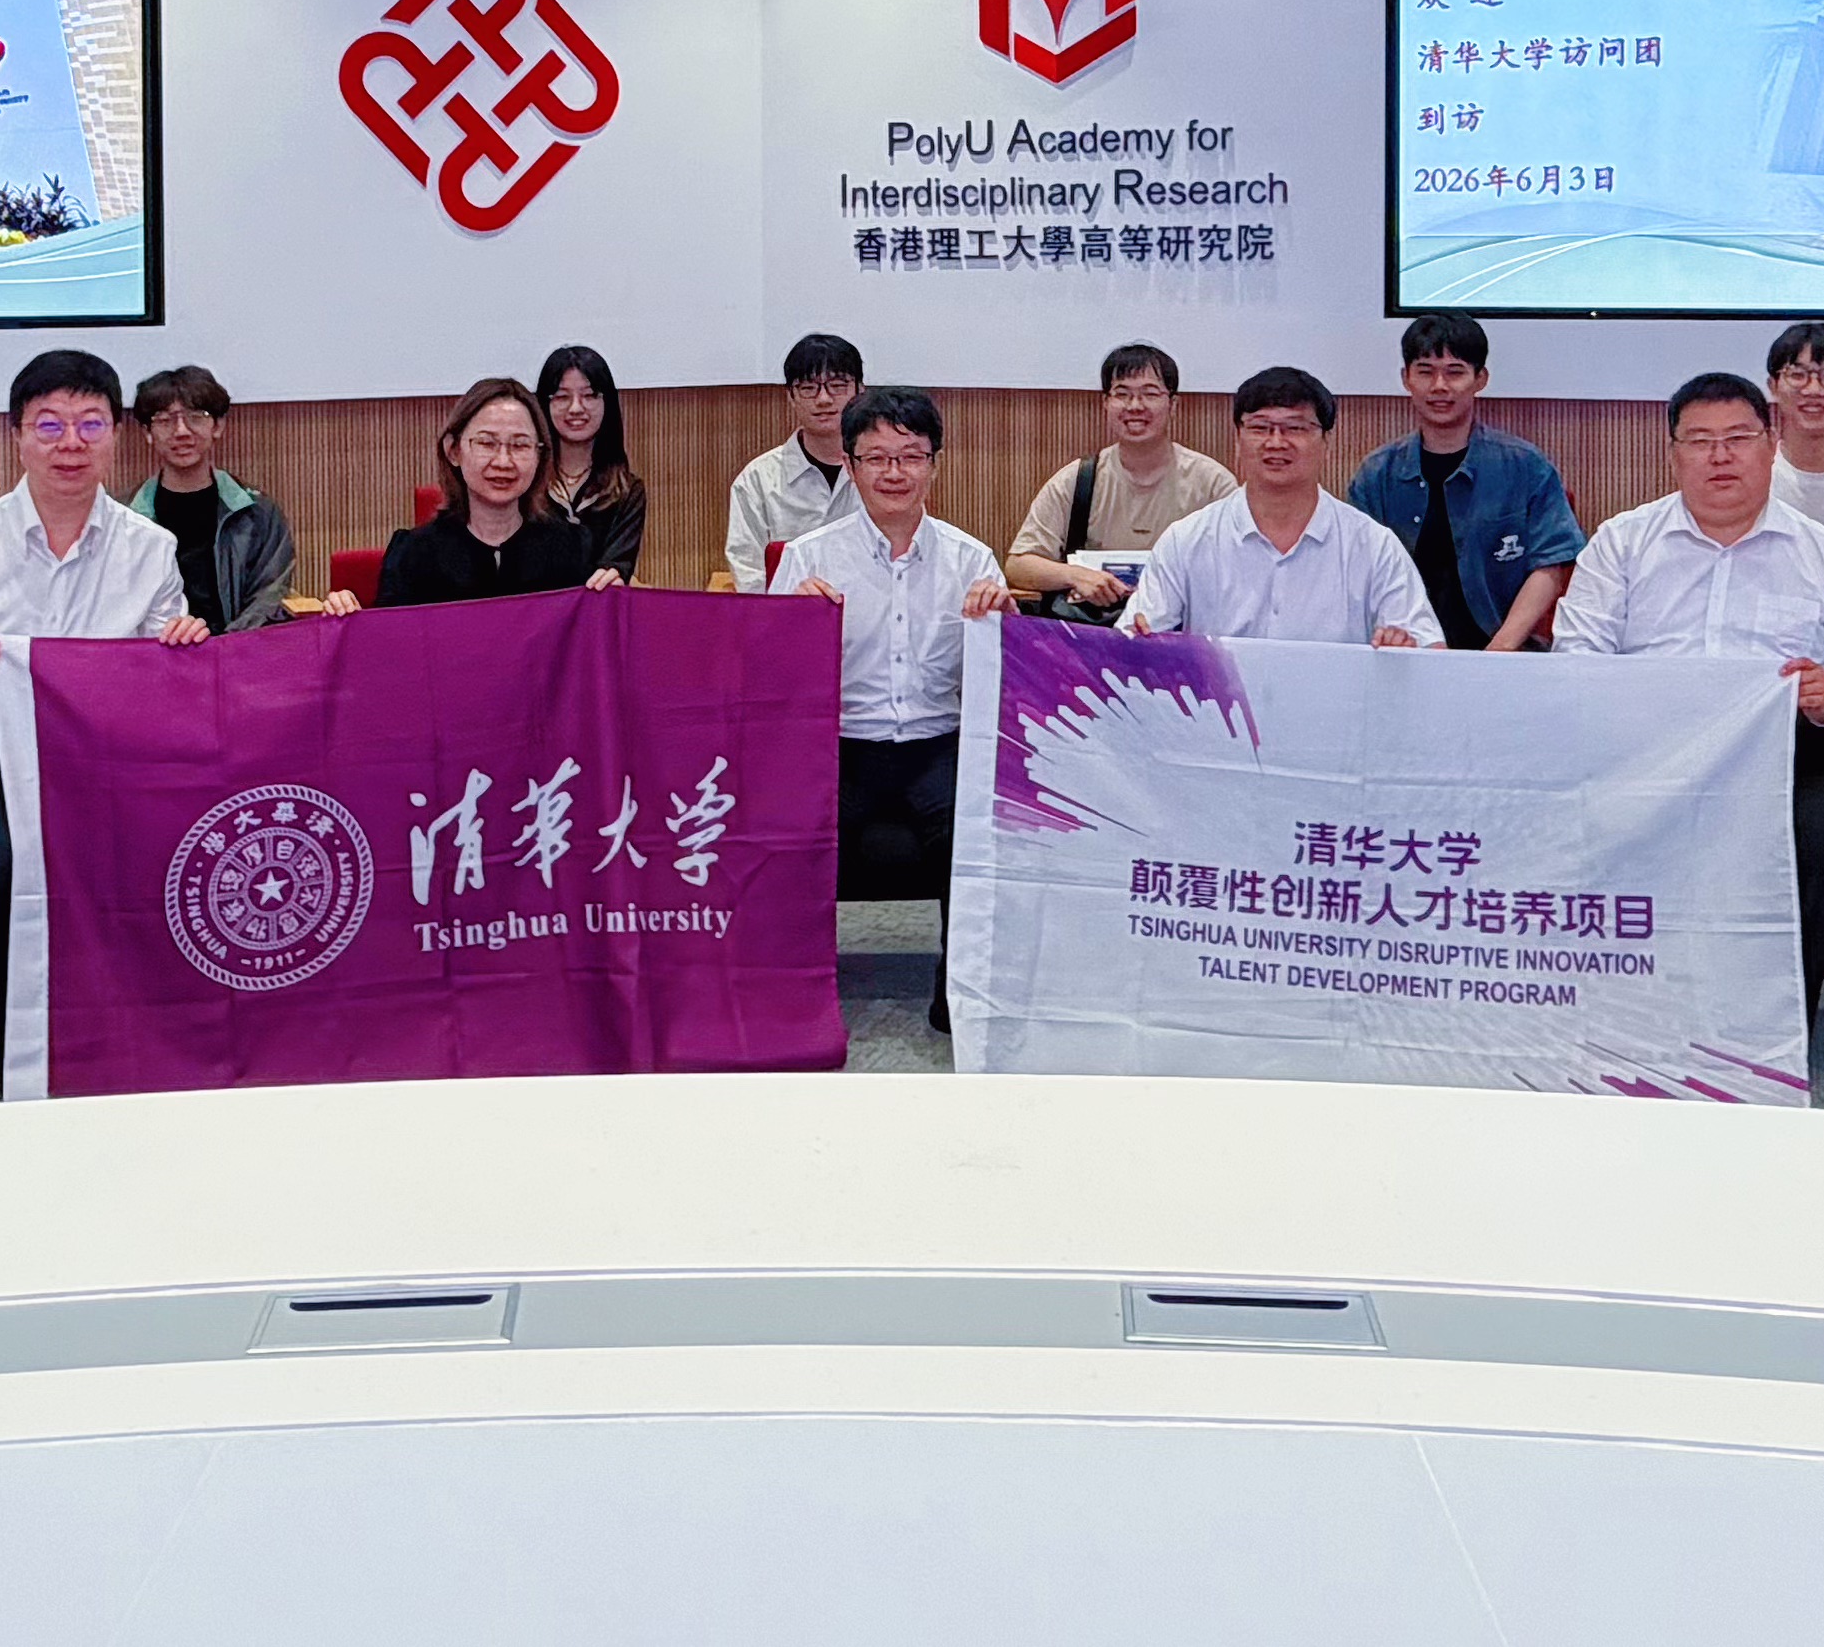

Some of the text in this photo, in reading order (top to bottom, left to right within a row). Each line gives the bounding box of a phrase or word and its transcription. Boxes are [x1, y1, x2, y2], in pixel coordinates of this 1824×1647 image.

[1417, 36, 1662, 74] 清华大学访问团
[1416, 102, 1485, 135] 到访
[887, 119, 1233, 166] PolyU Academy for
[840, 168, 1289, 214] Interdisciplinary Research
[1413, 164, 1615, 198] 2026年6月3日
[854, 224, 1275, 262] 香港理工大學高等研究院
[1293, 820, 1481, 876] 清华大学
[185, 874, 228, 959] TSINGHUA
[314, 852, 354, 943] UNIVERSITY
[1129, 858, 1653, 940] 颠覆性创新人才培养项目
[413, 911, 569, 952] Tsinghua
[1128, 914, 1655, 976] TSINGHUA UNIVERSITY DISRUPTIVE INNOVATION
[1198, 955, 1576, 1007] TALENT DEVELOPMENT PROGRAM
